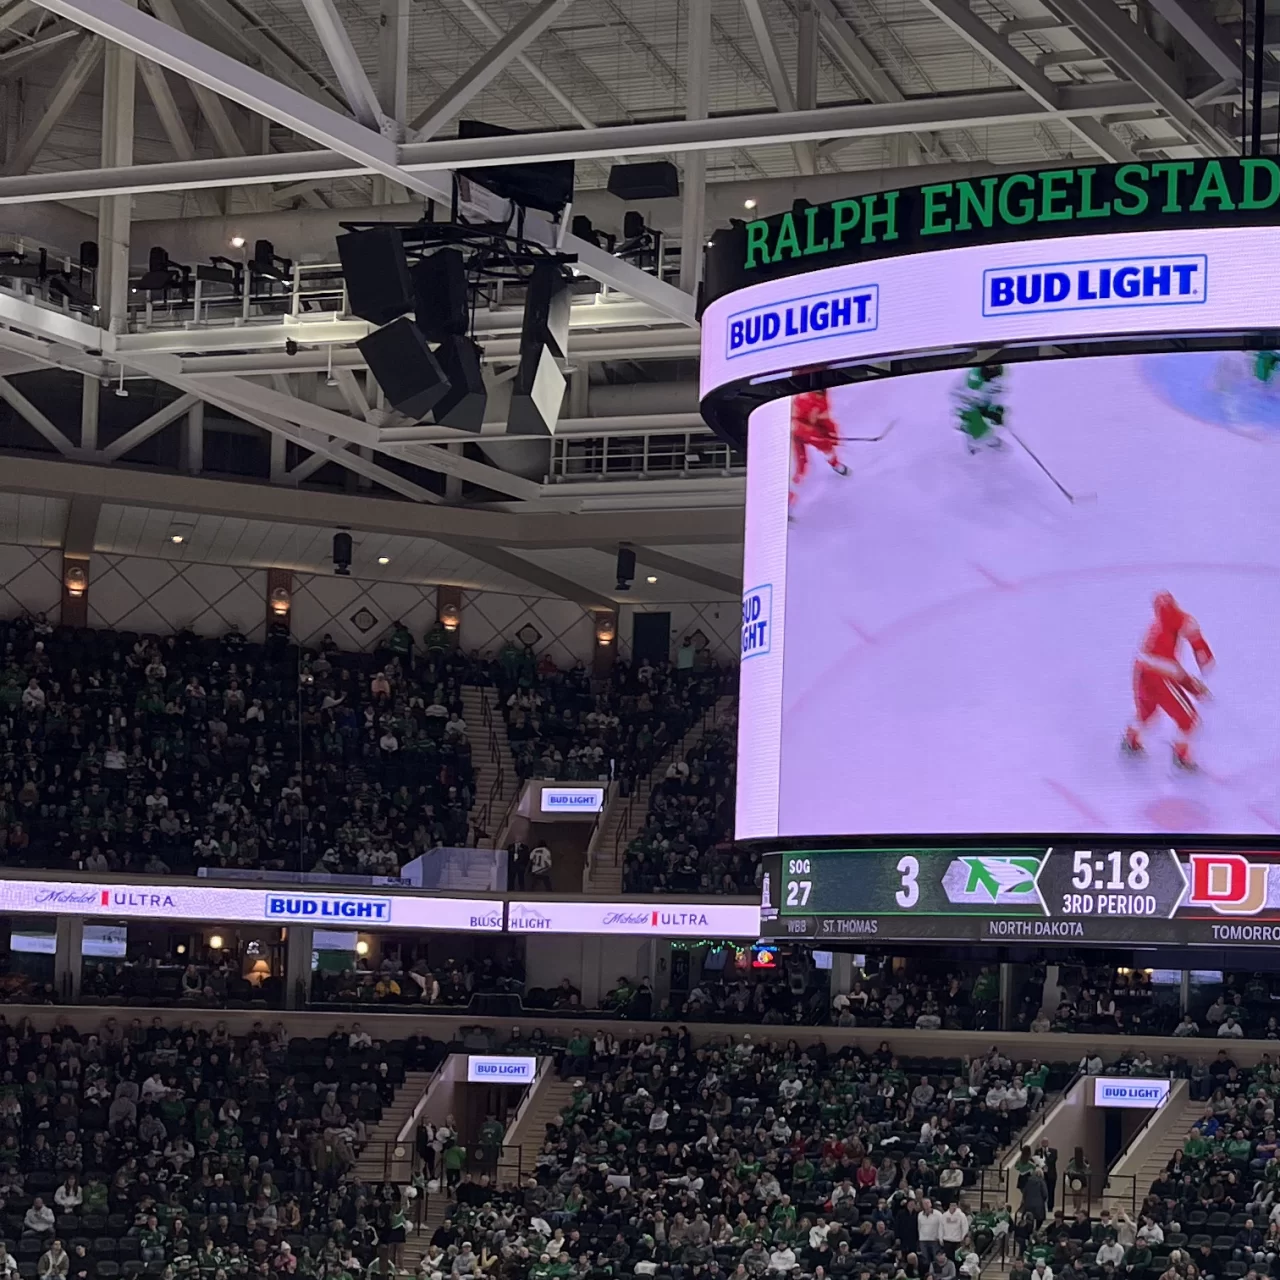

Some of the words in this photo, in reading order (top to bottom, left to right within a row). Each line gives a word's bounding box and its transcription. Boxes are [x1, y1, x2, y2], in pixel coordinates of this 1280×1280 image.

[743, 190, 899, 269] RALPH
[990, 272, 1070, 308] BUD
[1078, 264, 1198, 301] LIGHT
[729, 311, 780, 349] BUD
[785, 295, 872, 337] LIGHT
[550, 796, 568, 804] BUD
[569, 796, 595, 804] LIGHT
[789, 859, 810, 874] SOG
[1071, 850, 1150, 890] 5:18
[895, 856, 920, 908] 3
[114, 893, 176, 908] ULTRA
[786, 881, 812, 906] 27
[270, 899, 317, 915] BUD
[322, 901, 387, 919] LIGHT
[1062, 894, 1094, 913] 3RD
[1097, 894, 1156, 915] PERIOD
[661, 912, 708, 926] ULTRA
[787, 919, 807, 933] WBB
[837, 920, 878, 933] THOMAS
[989, 921, 1032, 935] NORTH
[1034, 921, 1084, 936] DAKOTA
[477, 1065, 497, 1073] BUD
[499, 1066, 526, 1074] LIGHT
[1105, 1088, 1127, 1096] BUD
[1129, 1089, 1160, 1098] LIGHT
